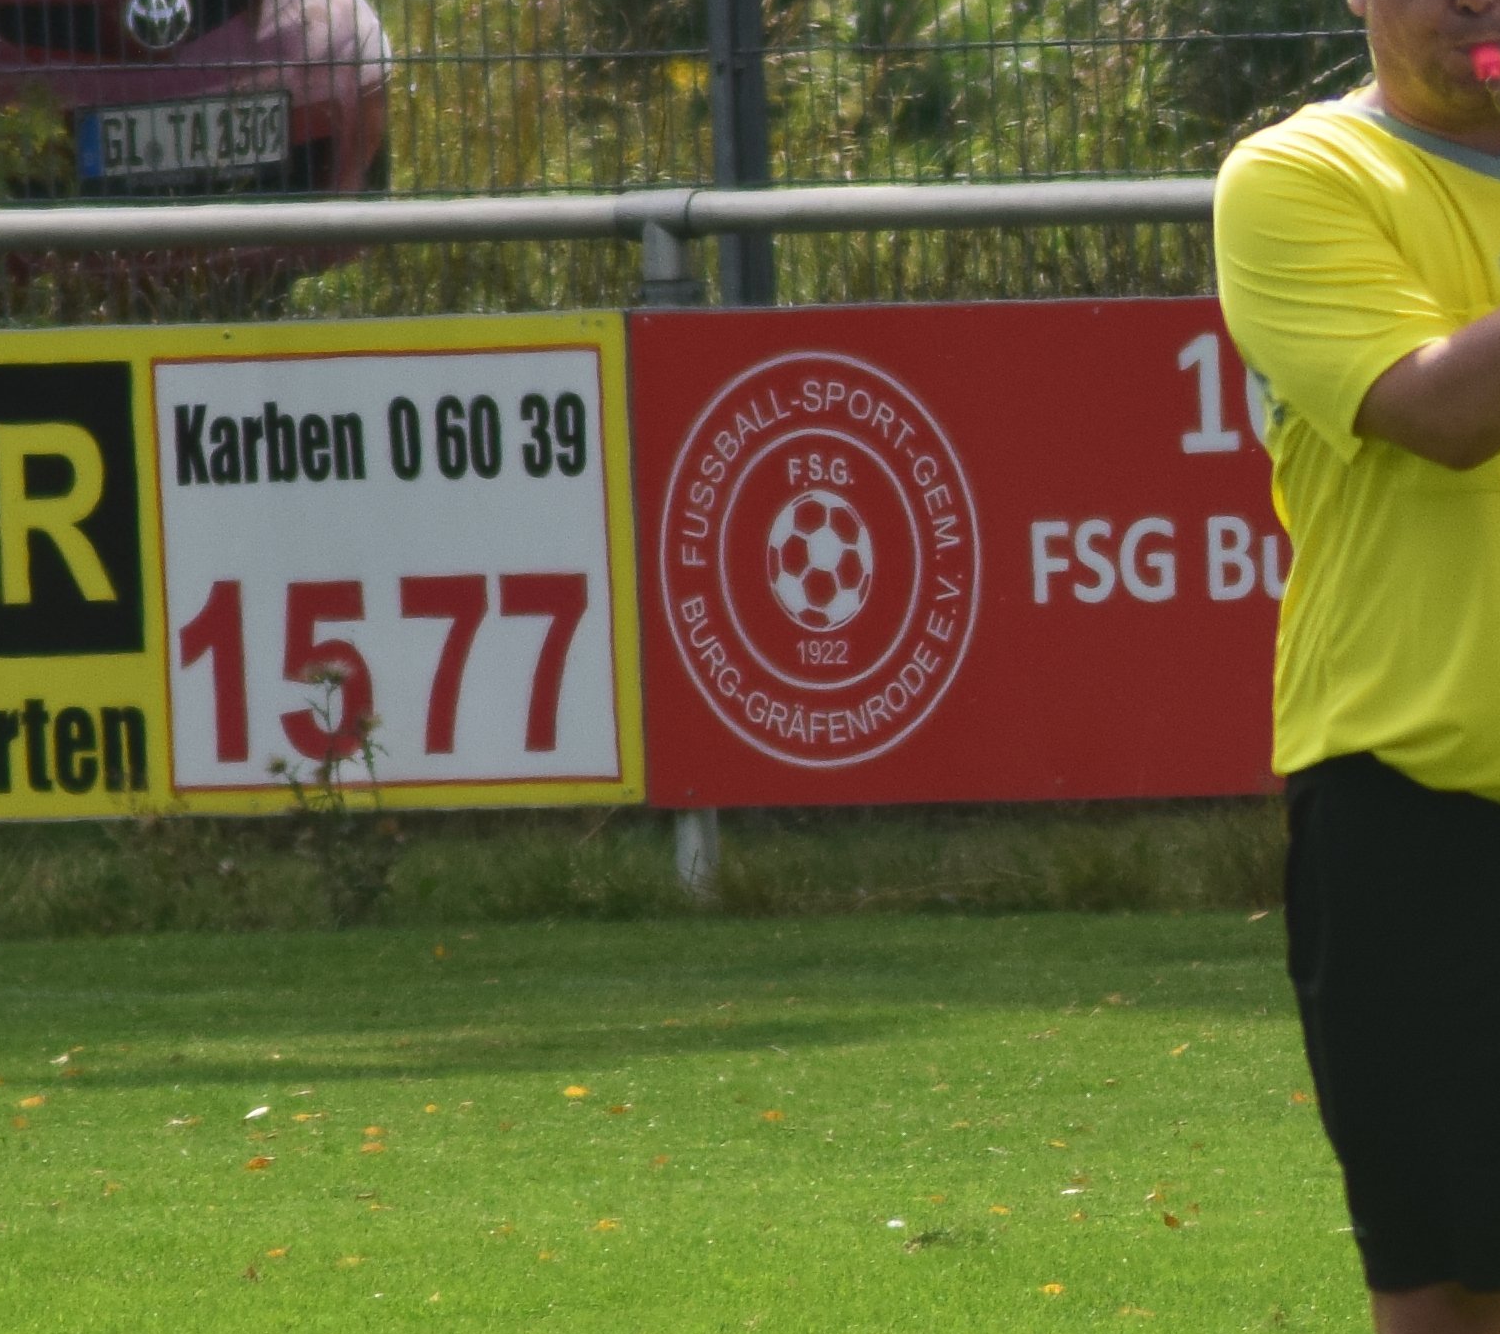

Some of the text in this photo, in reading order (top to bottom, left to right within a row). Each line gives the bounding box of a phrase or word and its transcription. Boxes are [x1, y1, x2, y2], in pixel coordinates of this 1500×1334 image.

[174, 392, 586, 487] Karben 0 60 39
[681, 379, 962, 569] FUSSBALL-SPORT-GEM.
[787, 455, 855, 487] F.S.G.
[1030, 517, 1176, 605] FSG
[179, 572, 589, 764] 1577
[681, 595, 941, 744] BURG-GRÄFENRODE
[797, 640, 849, 666] 1922
